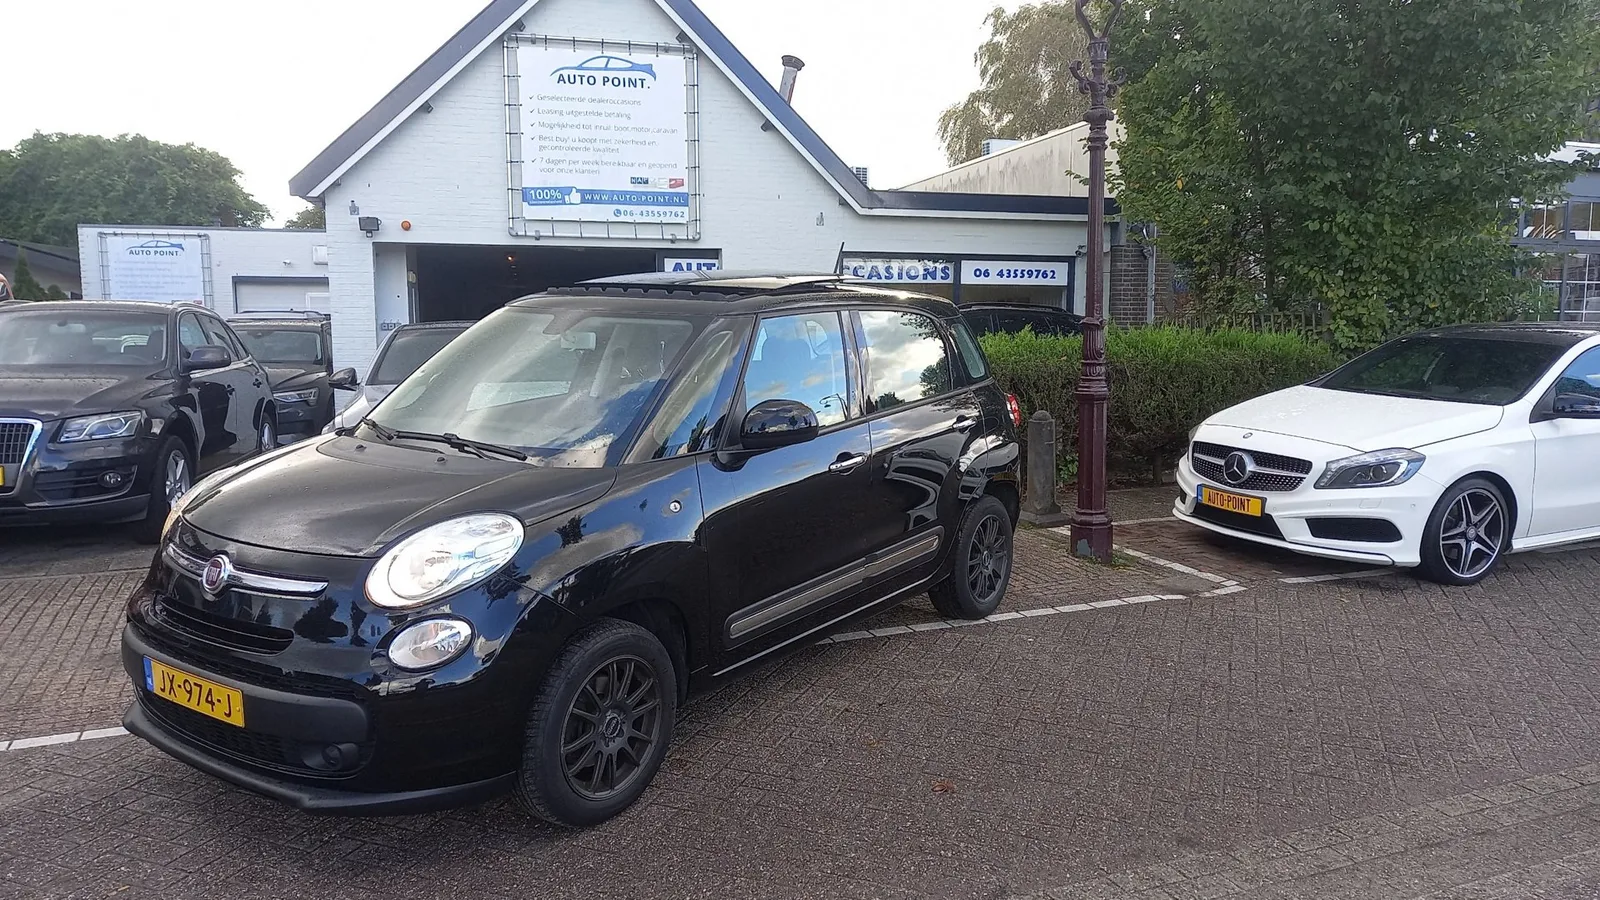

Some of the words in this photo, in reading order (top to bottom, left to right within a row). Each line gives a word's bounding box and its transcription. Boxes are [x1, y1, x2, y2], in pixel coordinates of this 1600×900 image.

[557, 73, 597, 86] AUTO
[602, 76, 651, 89] POINT.
[537, 93, 587, 103] Geselecteerde
[588, 96, 642, 106] dealeroccasions
[537, 107, 564, 117] Leasing
[565, 109, 603, 119] uitgestelde
[604, 111, 632, 120] betaling
[538, 121, 580, 131] Mogelijkheid
[538, 134, 554, 142] Best
[578, 136, 597, 144] koopt
[614, 138, 646, 146] zekerheid
[538, 144, 591, 153] gecontroleerde
[592, 146, 620, 154] kwaliteit
[545, 158, 567, 166] dagen
[568, 159, 580, 167] per
[600, 159, 636, 168] bereikbaar
[648, 162, 678, 170] geopend
[529, 189, 562, 200] 100%
[584, 192, 685, 204] WWW.AUTO-POINT.NL
[623, 209, 685, 218] 06-43559762
[672, 262, 720, 272] AUT
[973, 268, 991, 278] 06
[996, 268, 1057, 280] 43559762
[1207, 490, 1251, 512] AUTO-POINT
[160, 669, 232, 718] JX-974-J
